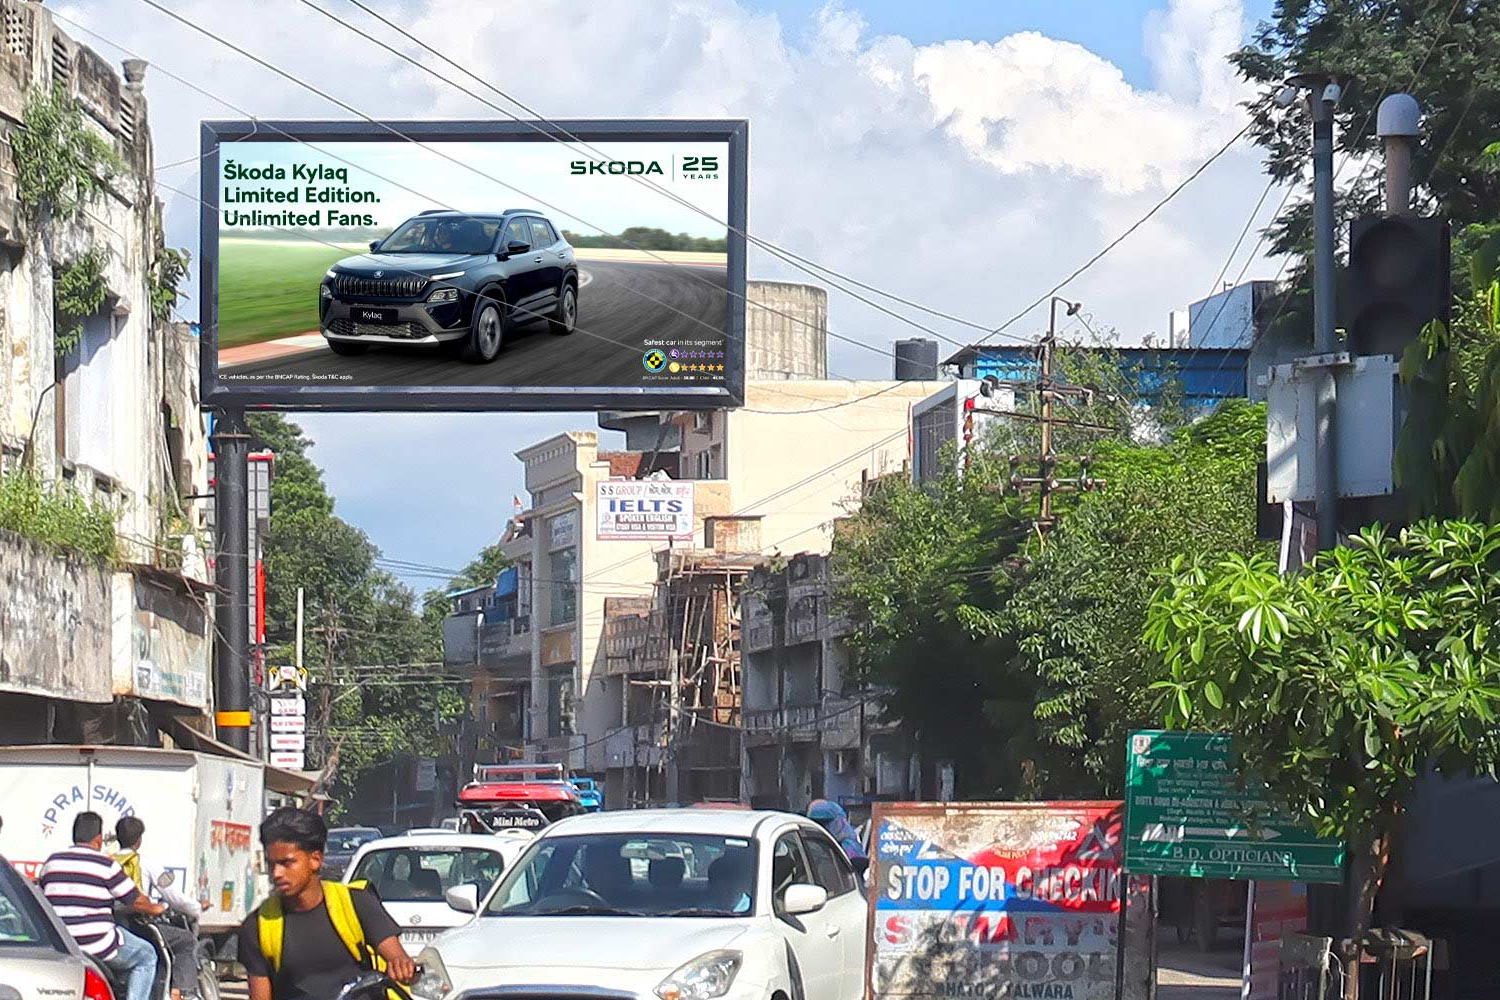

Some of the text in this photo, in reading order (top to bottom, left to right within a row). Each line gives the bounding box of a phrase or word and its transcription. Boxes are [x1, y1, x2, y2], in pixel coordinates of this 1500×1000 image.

[682, 156, 719, 171] 25
[224, 159, 348, 184] Škoda Kylaq
[224, 187, 381, 203] Limited Edition.
[224, 210, 379, 226] Unlimited Fans.
[362, 311, 382, 321] Kylaq
[600, 485, 607, 495] S
[608, 485, 614, 495] S
[609, 499, 683, 512] IELTS
[618, 514, 674, 522] SPOKEN ENGLISH
[493, 817, 539, 827] Mini Metro
[1173, 847, 1204, 861] B.D.
[887, 865, 950, 900] STOP
[959, 866, 1005, 900] FOR
[1008, 982, 1074, 1000] TALWARA
